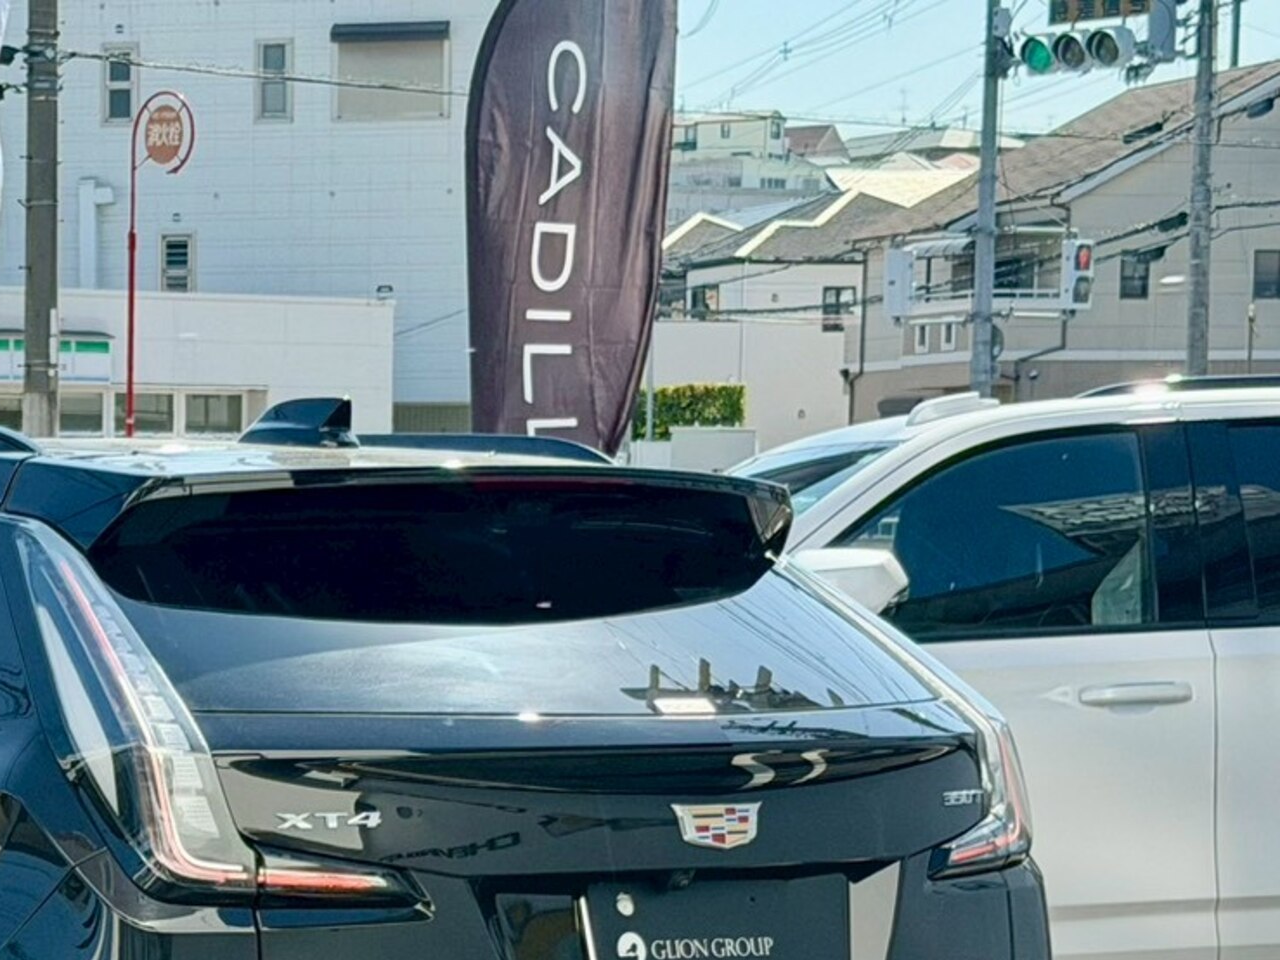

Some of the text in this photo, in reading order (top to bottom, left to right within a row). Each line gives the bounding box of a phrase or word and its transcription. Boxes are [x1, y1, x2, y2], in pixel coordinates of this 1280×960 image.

[276, 810, 383, 830] XT4
[651, 936, 774, 960] GLION GROUP
